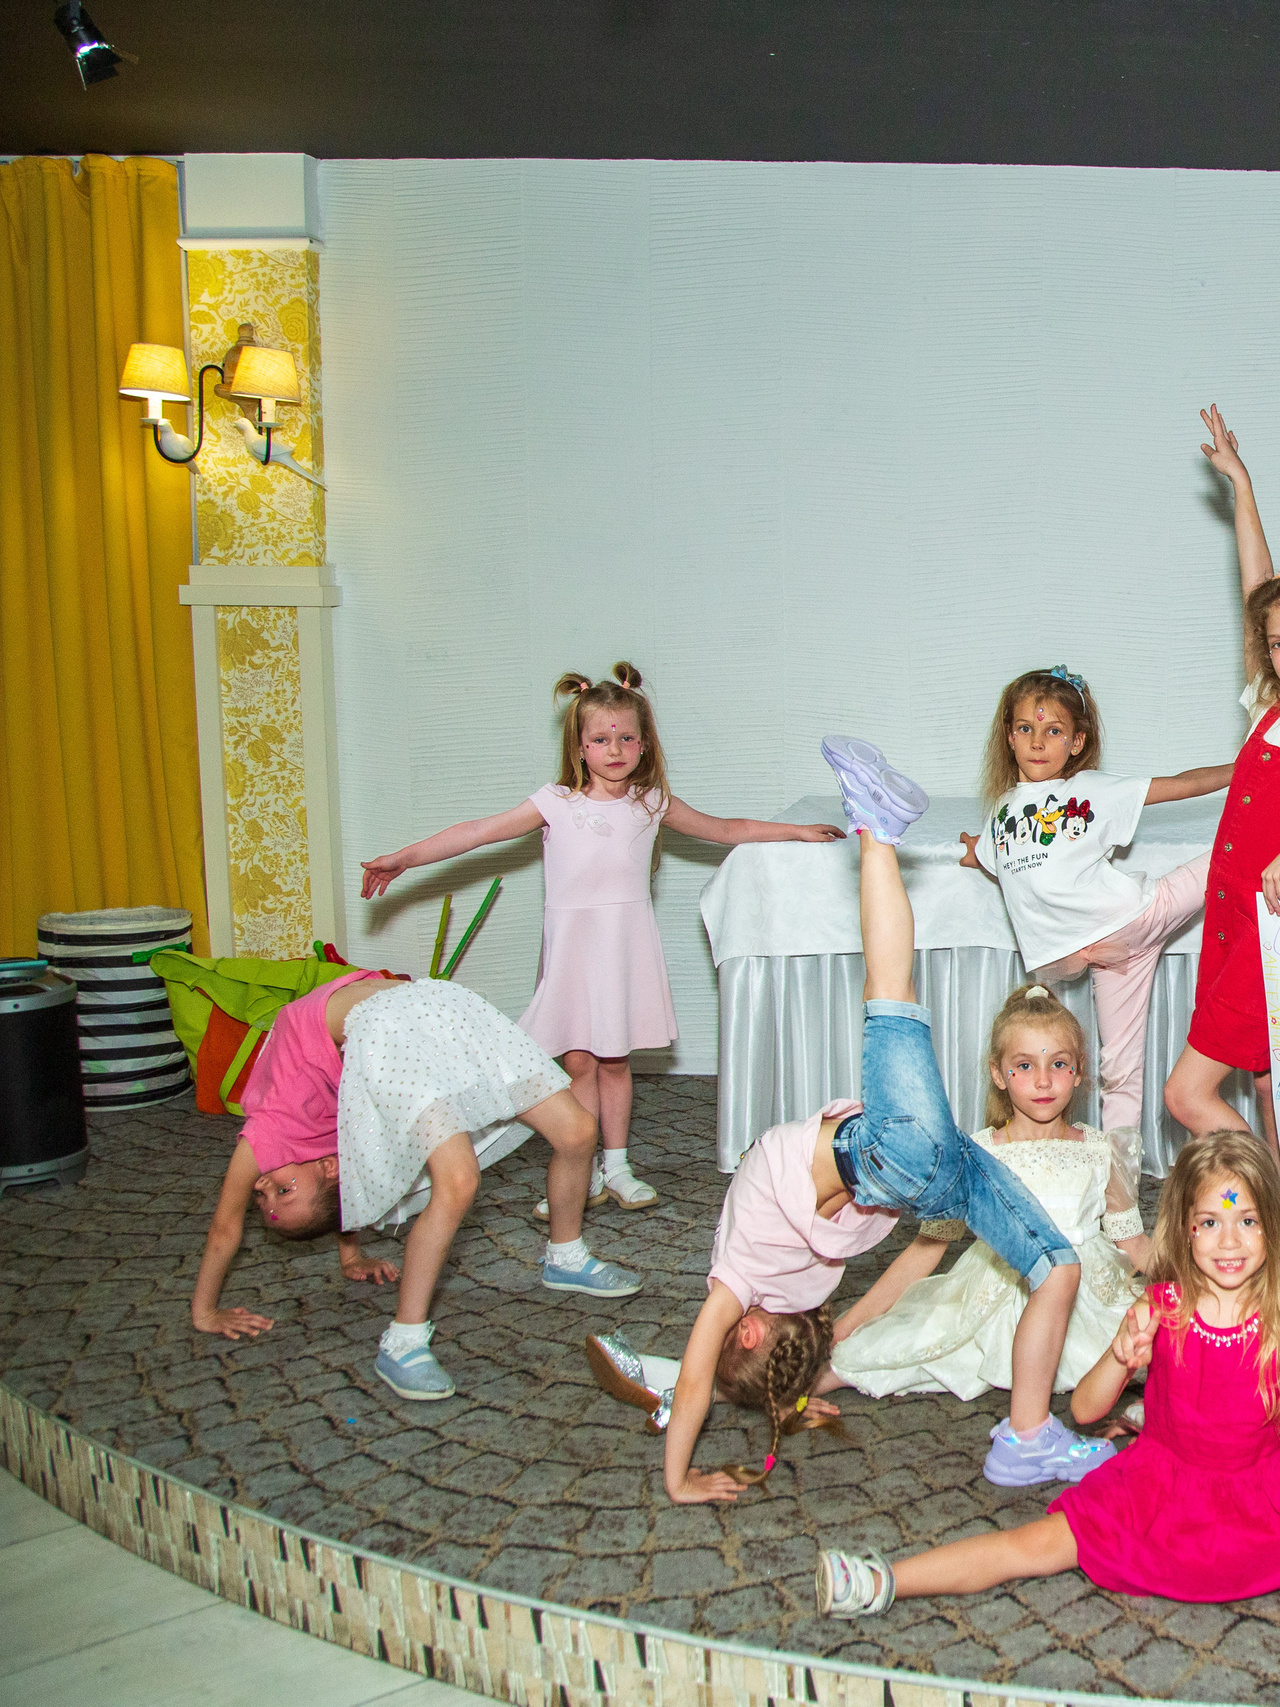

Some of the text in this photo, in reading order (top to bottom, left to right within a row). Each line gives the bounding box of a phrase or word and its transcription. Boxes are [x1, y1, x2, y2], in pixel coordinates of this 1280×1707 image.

[1003, 852, 1048, 870] HEY! THE FUN
[1011, 861, 1043, 875] STARTS NOW
